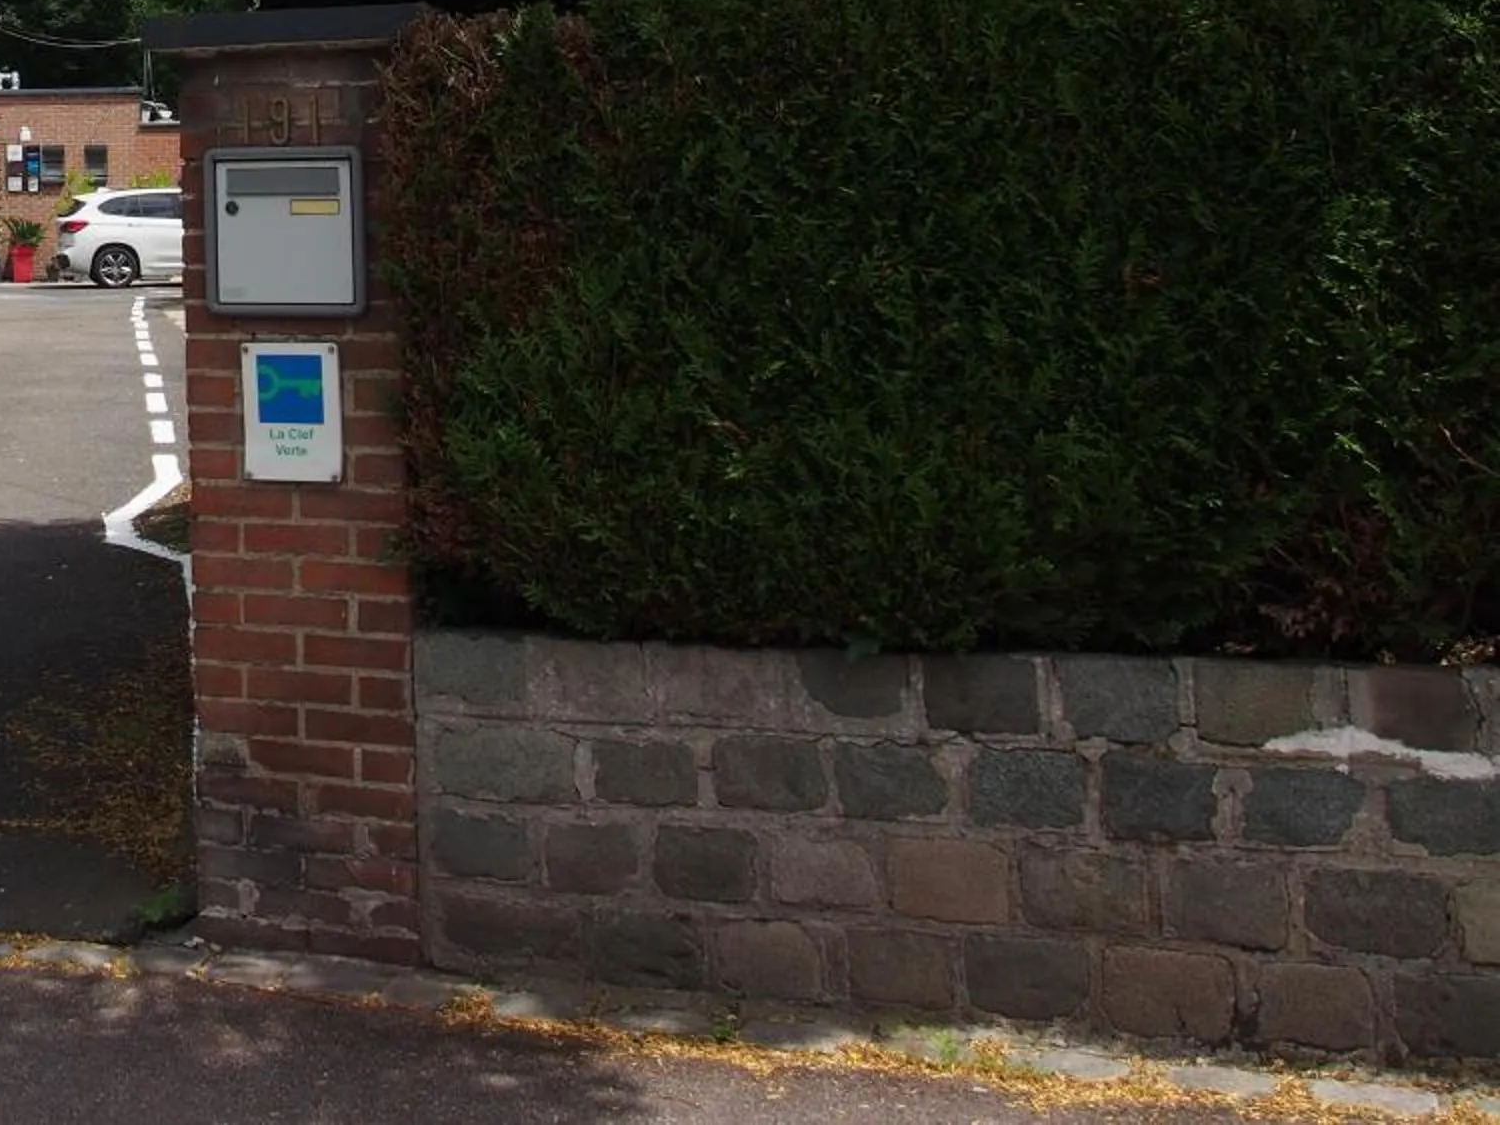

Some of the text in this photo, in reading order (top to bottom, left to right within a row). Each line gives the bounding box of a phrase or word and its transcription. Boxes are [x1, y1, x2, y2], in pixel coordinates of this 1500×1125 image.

[237, 94, 320, 146] 191
[269, 427, 314, 441] La Clef
[275, 444, 308, 456] Verte
